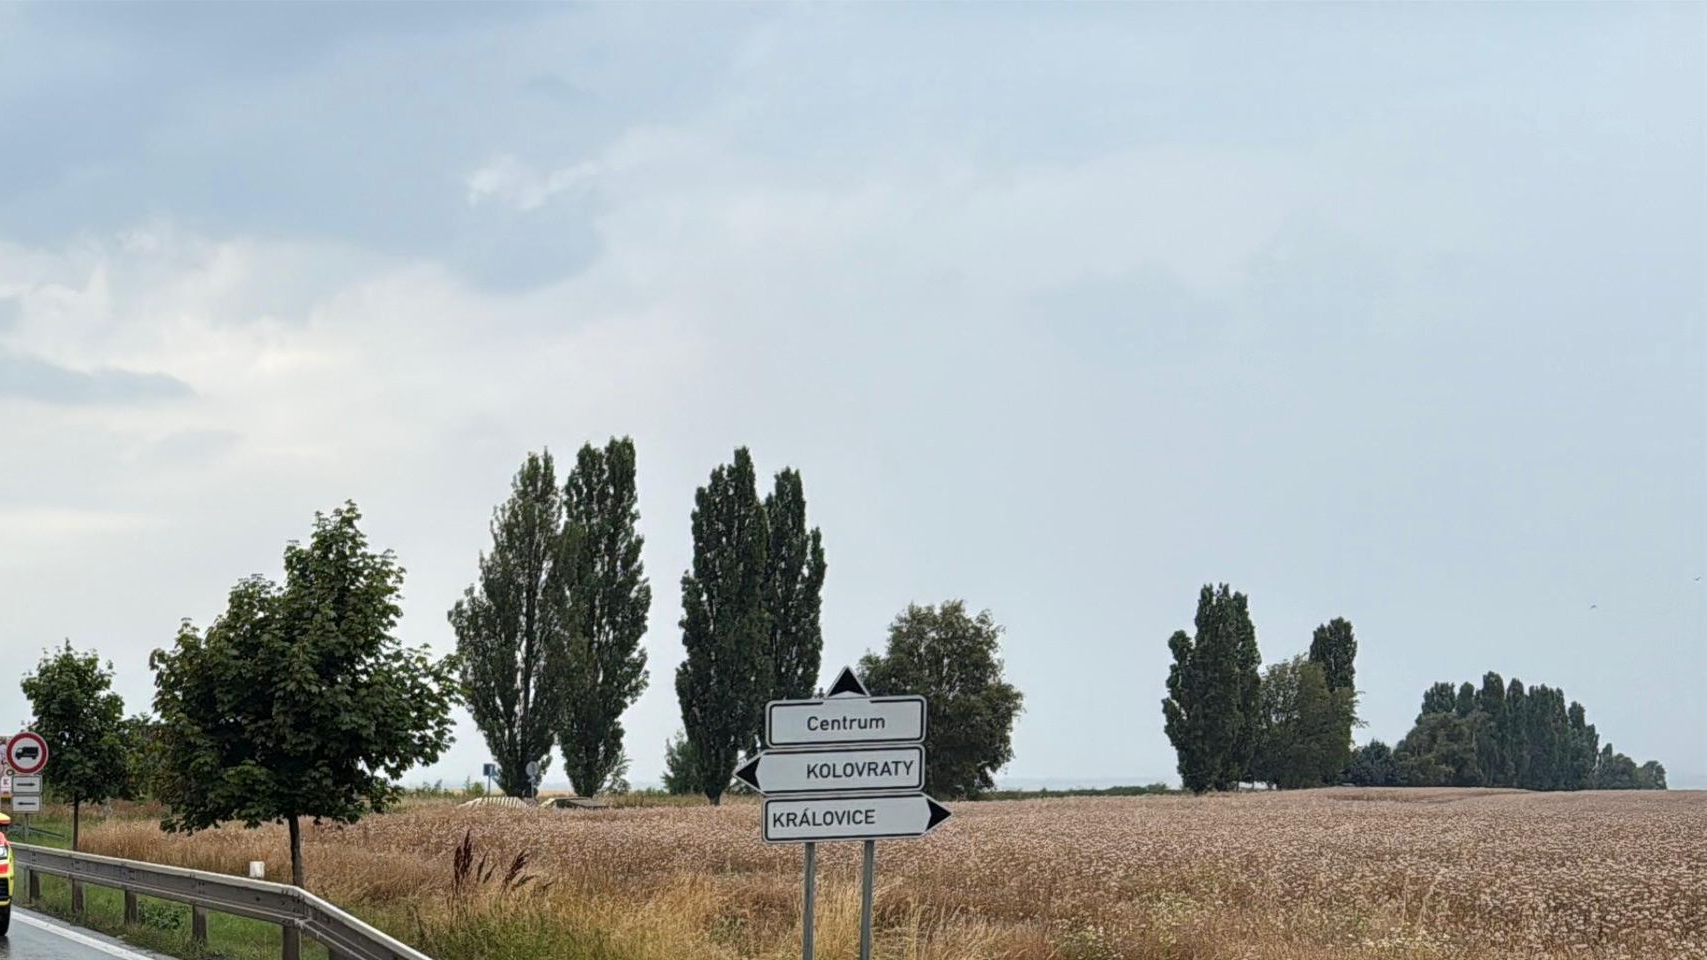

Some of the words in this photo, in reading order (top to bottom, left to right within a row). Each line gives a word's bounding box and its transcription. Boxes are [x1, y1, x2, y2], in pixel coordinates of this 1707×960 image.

[806, 716, 886, 731] Centrum
[806, 760, 914, 779] KOLOVRATY
[772, 808, 876, 828] KRÁLOVICE
